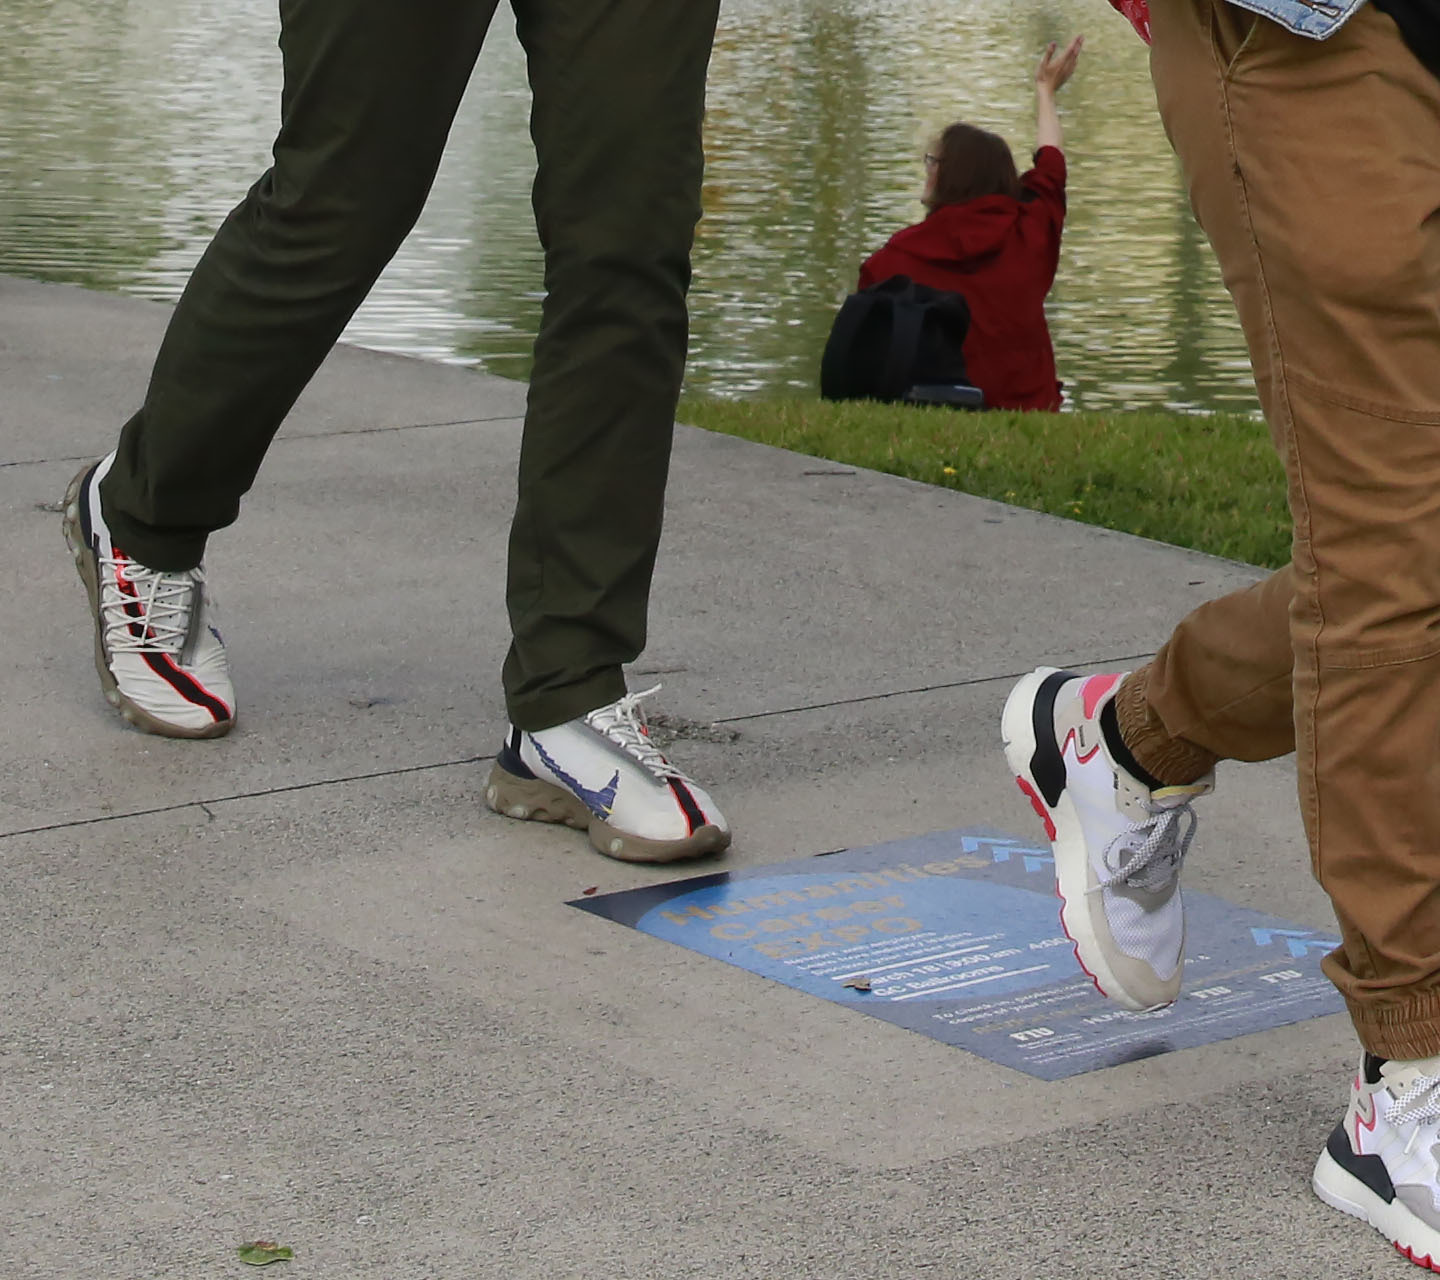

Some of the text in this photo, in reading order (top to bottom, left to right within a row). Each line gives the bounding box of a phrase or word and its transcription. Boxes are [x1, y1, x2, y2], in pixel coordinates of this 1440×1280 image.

[659, 854, 994, 926] Humanities
[709, 893, 906, 940] Career
[753, 916, 922, 959] EXPO
[1010, 1027, 1055, 1041] FIU
[1190, 986, 1232, 999] FIU
[1259, 969, 1303, 984] FIU
